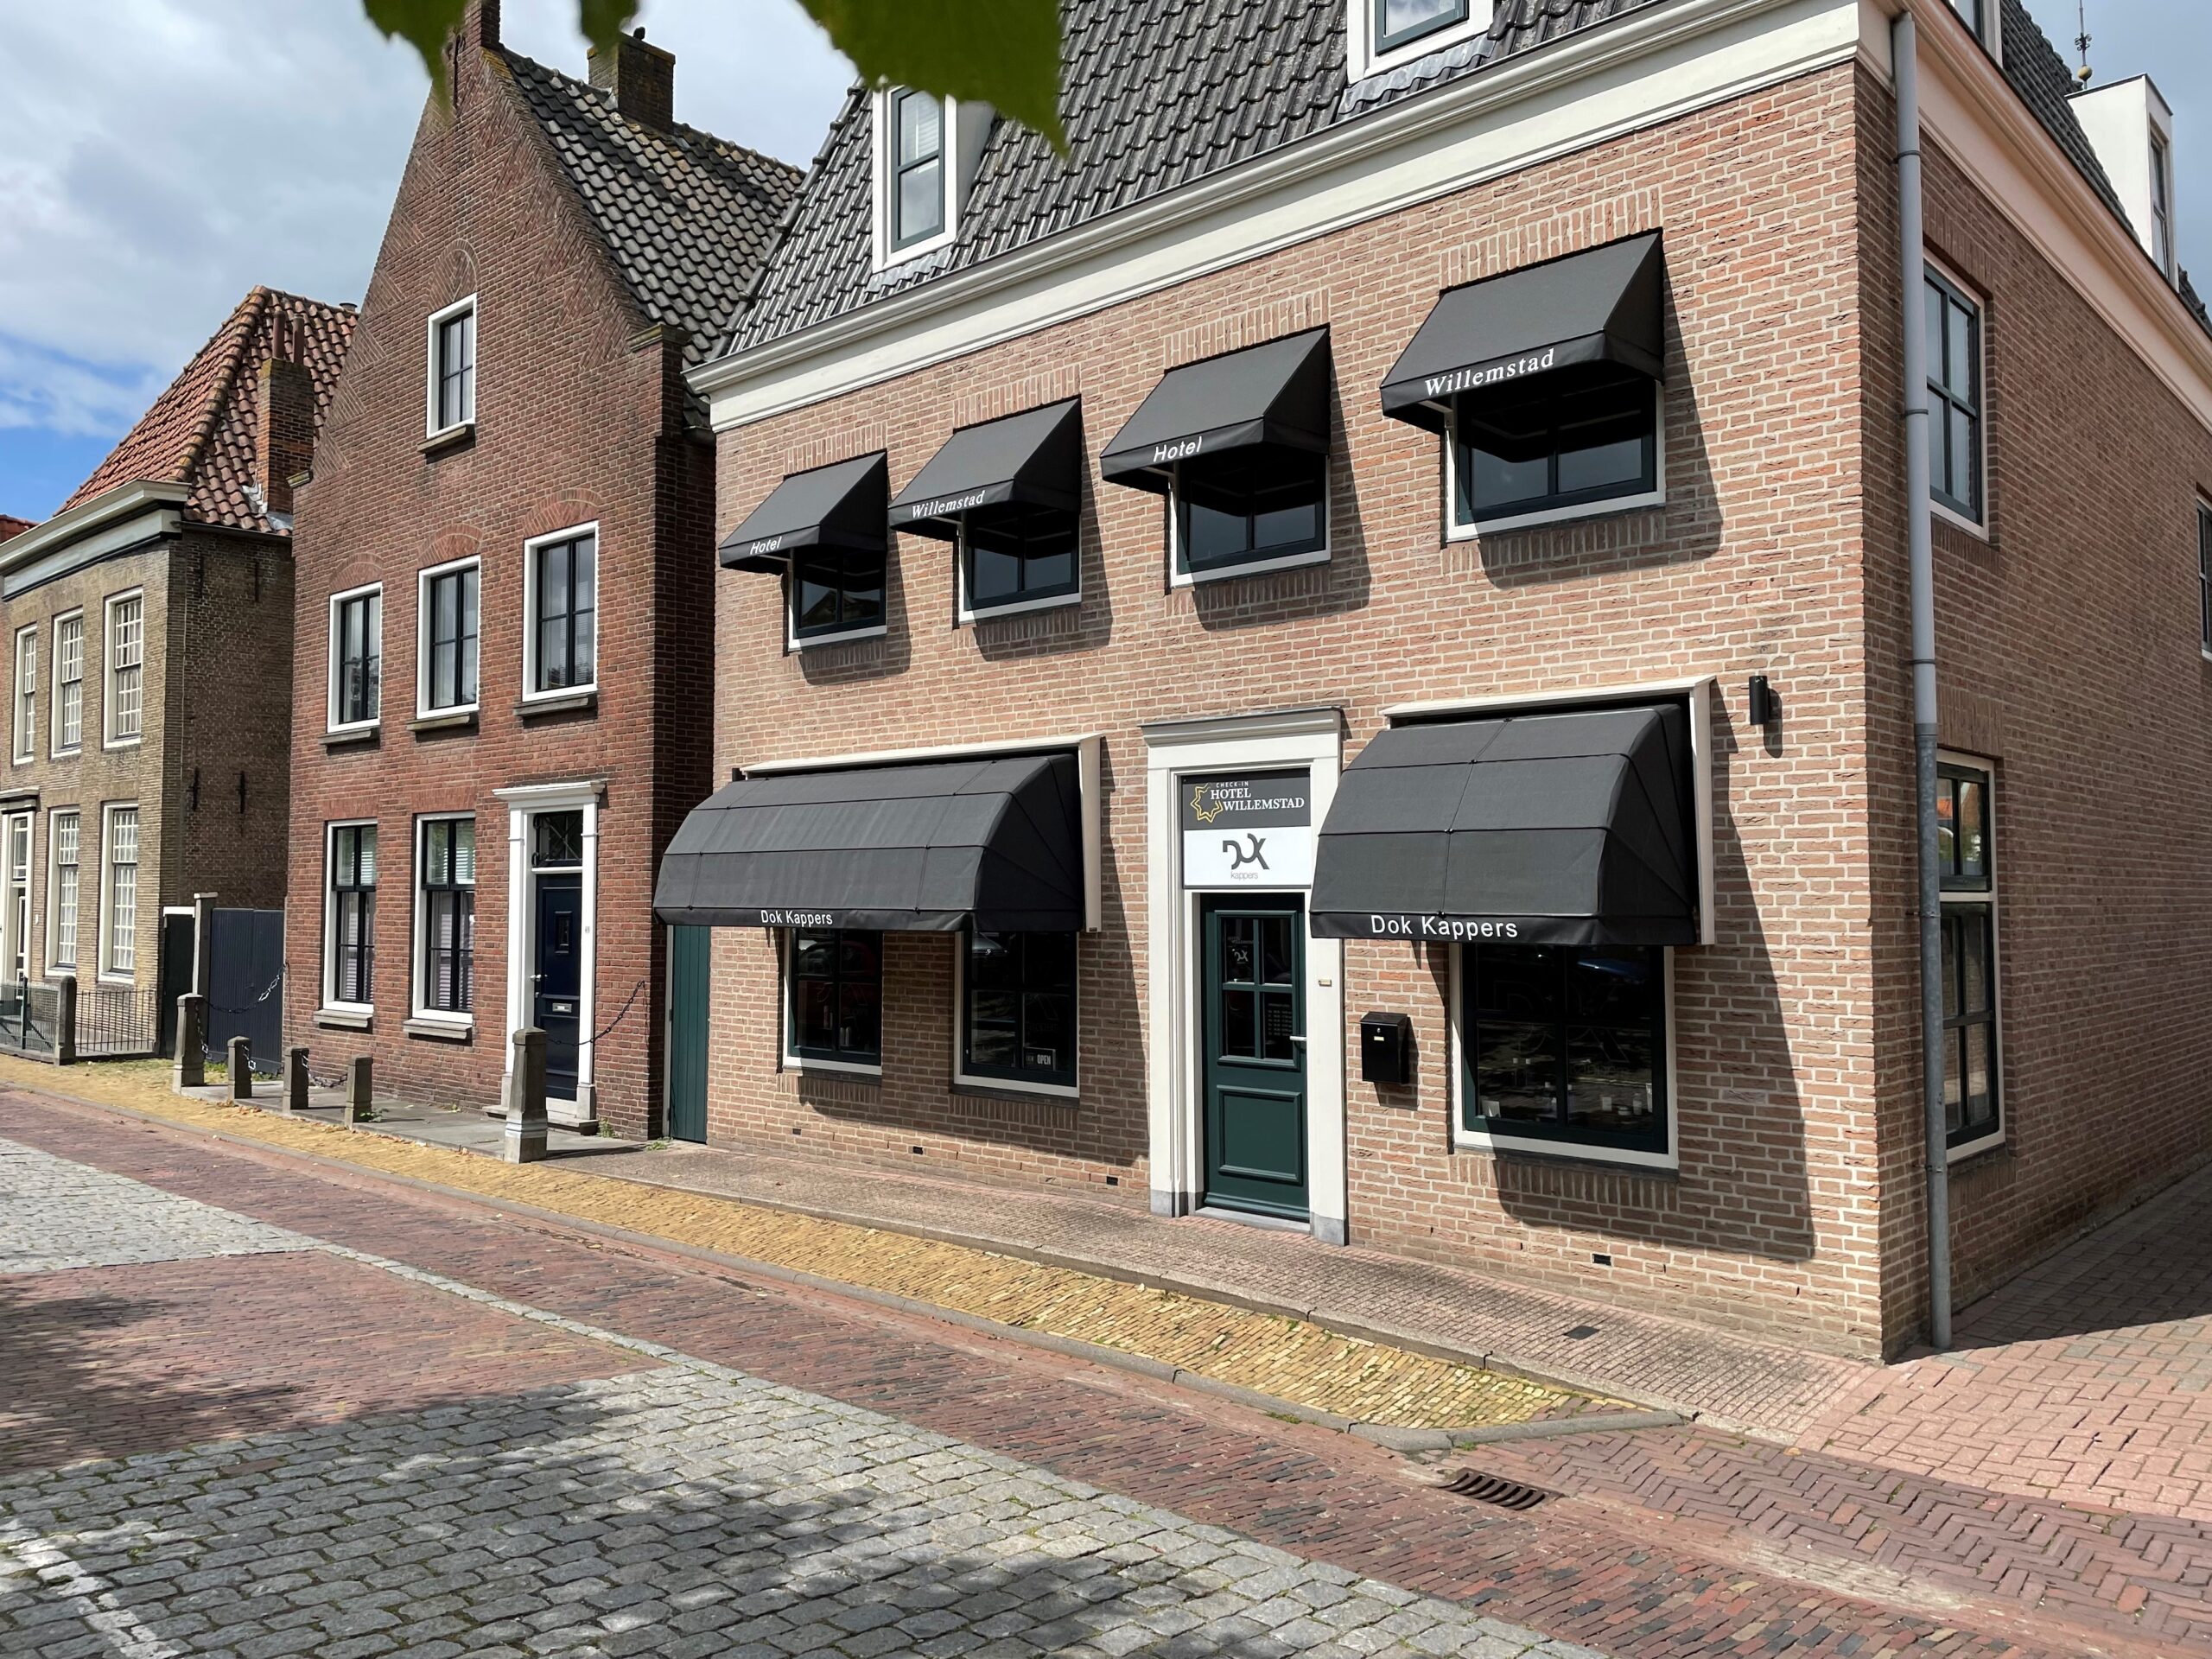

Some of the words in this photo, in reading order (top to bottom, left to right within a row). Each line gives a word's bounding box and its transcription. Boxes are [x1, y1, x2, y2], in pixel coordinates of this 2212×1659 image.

[1425, 347, 1554, 396] Willemstad
[1153, 435, 1203, 462] Hotel
[912, 490, 986, 518] Willemstad
[749, 536, 783, 555] Hotel
[1211, 788, 1252, 800] HOTEL
[1223, 798, 1305, 810] WILLEMSTAD
[1230, 871, 1259, 880] kappers
[760, 910, 783, 924] Dok
[785, 910, 833, 927] Kappers
[1370, 914, 1414, 934] Dok
[1421, 916, 1518, 940] Kappers
[1037, 1054, 1052, 1065] OPEN
